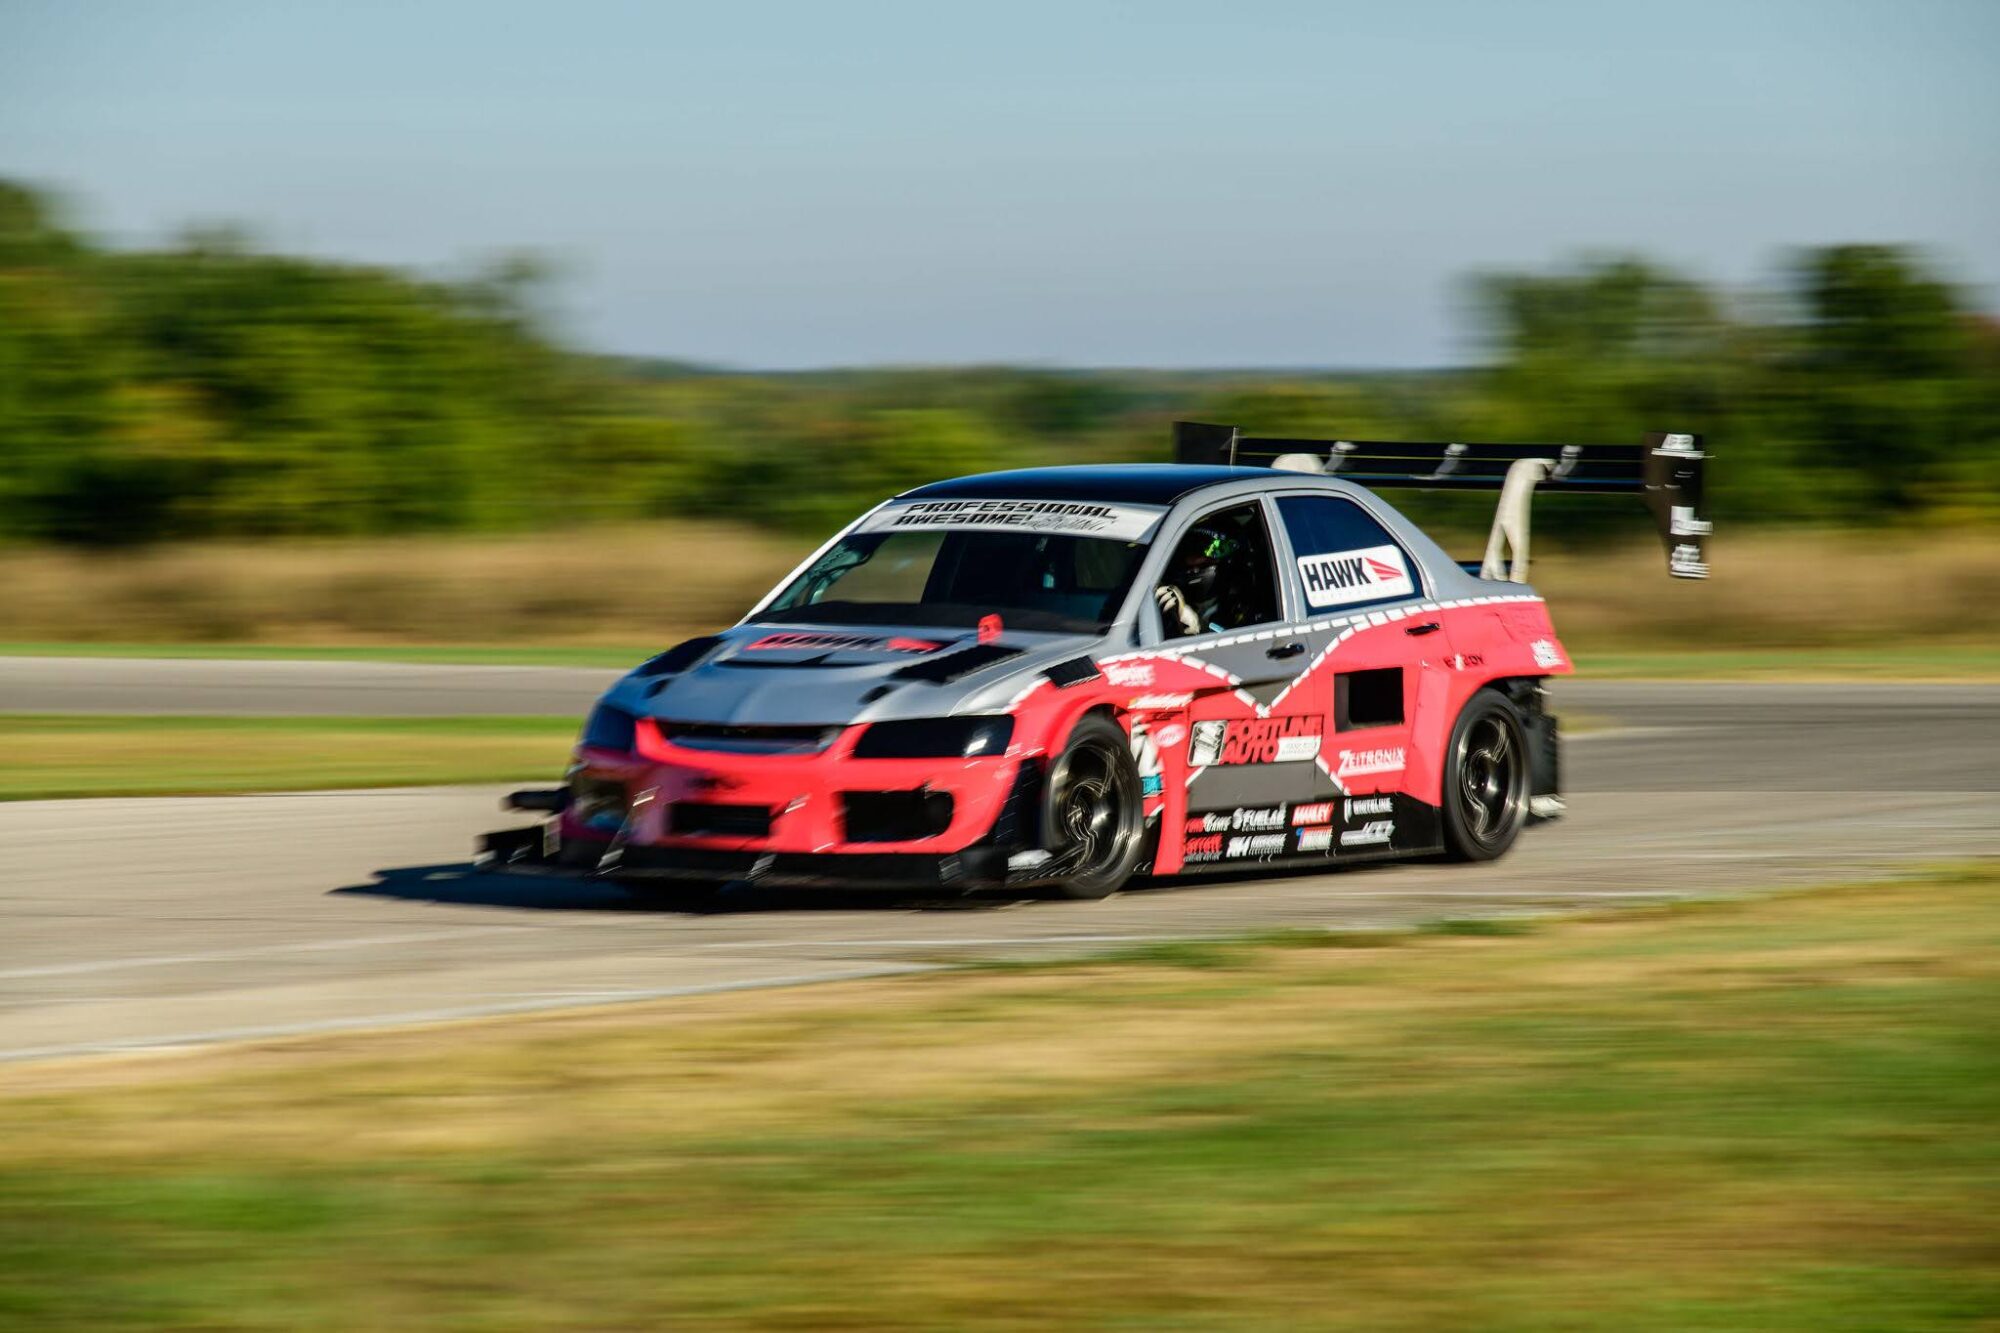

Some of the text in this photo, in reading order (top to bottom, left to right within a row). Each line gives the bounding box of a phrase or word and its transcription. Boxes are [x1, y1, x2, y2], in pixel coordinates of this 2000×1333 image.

[892, 513, 1034, 526] AWESOME!
[904, 502, 1118, 519] PROFESSIONAL
[1303, 557, 1372, 592] HAWK
[1224, 714, 1322, 744] FORTUNE
[1218, 738, 1279, 766] AUTO
[1337, 746, 1406, 777] ZEITRONIX
